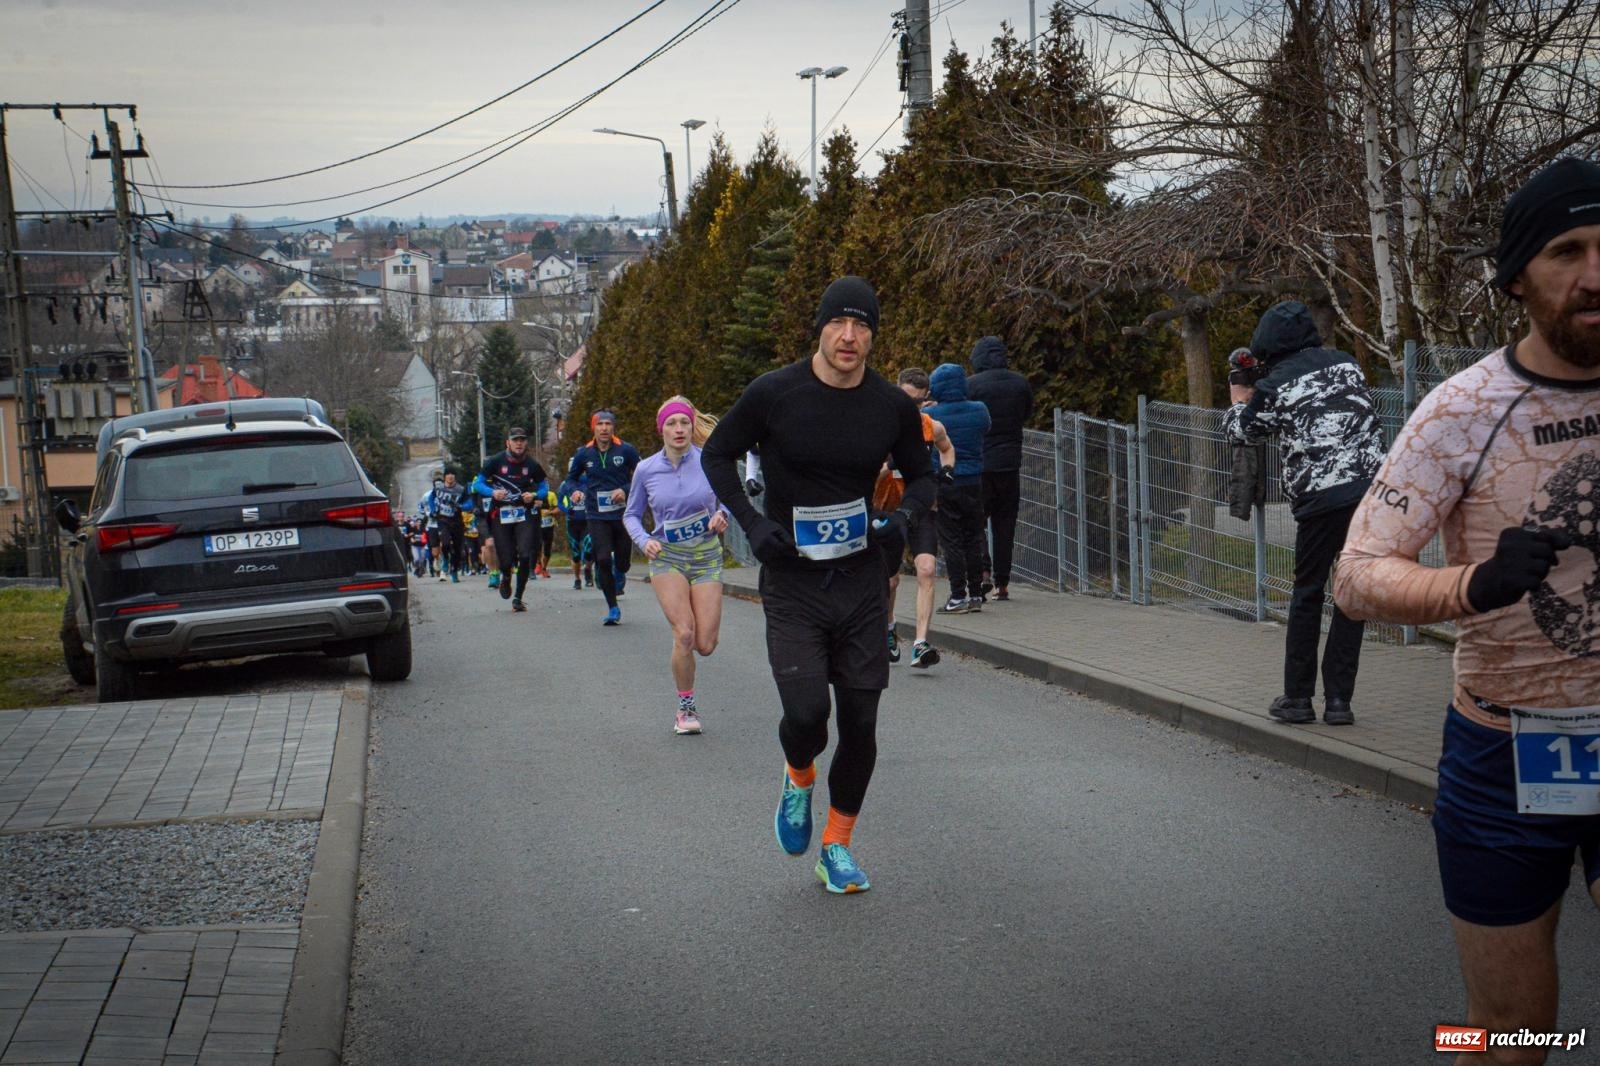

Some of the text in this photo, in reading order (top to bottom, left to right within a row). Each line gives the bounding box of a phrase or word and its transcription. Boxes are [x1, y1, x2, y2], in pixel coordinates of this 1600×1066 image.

[1371, 480, 1409, 515] TICA
[215, 530, 294, 551] OP 1239P
[674, 520, 706, 542] 153
[816, 519, 850, 543] 93
